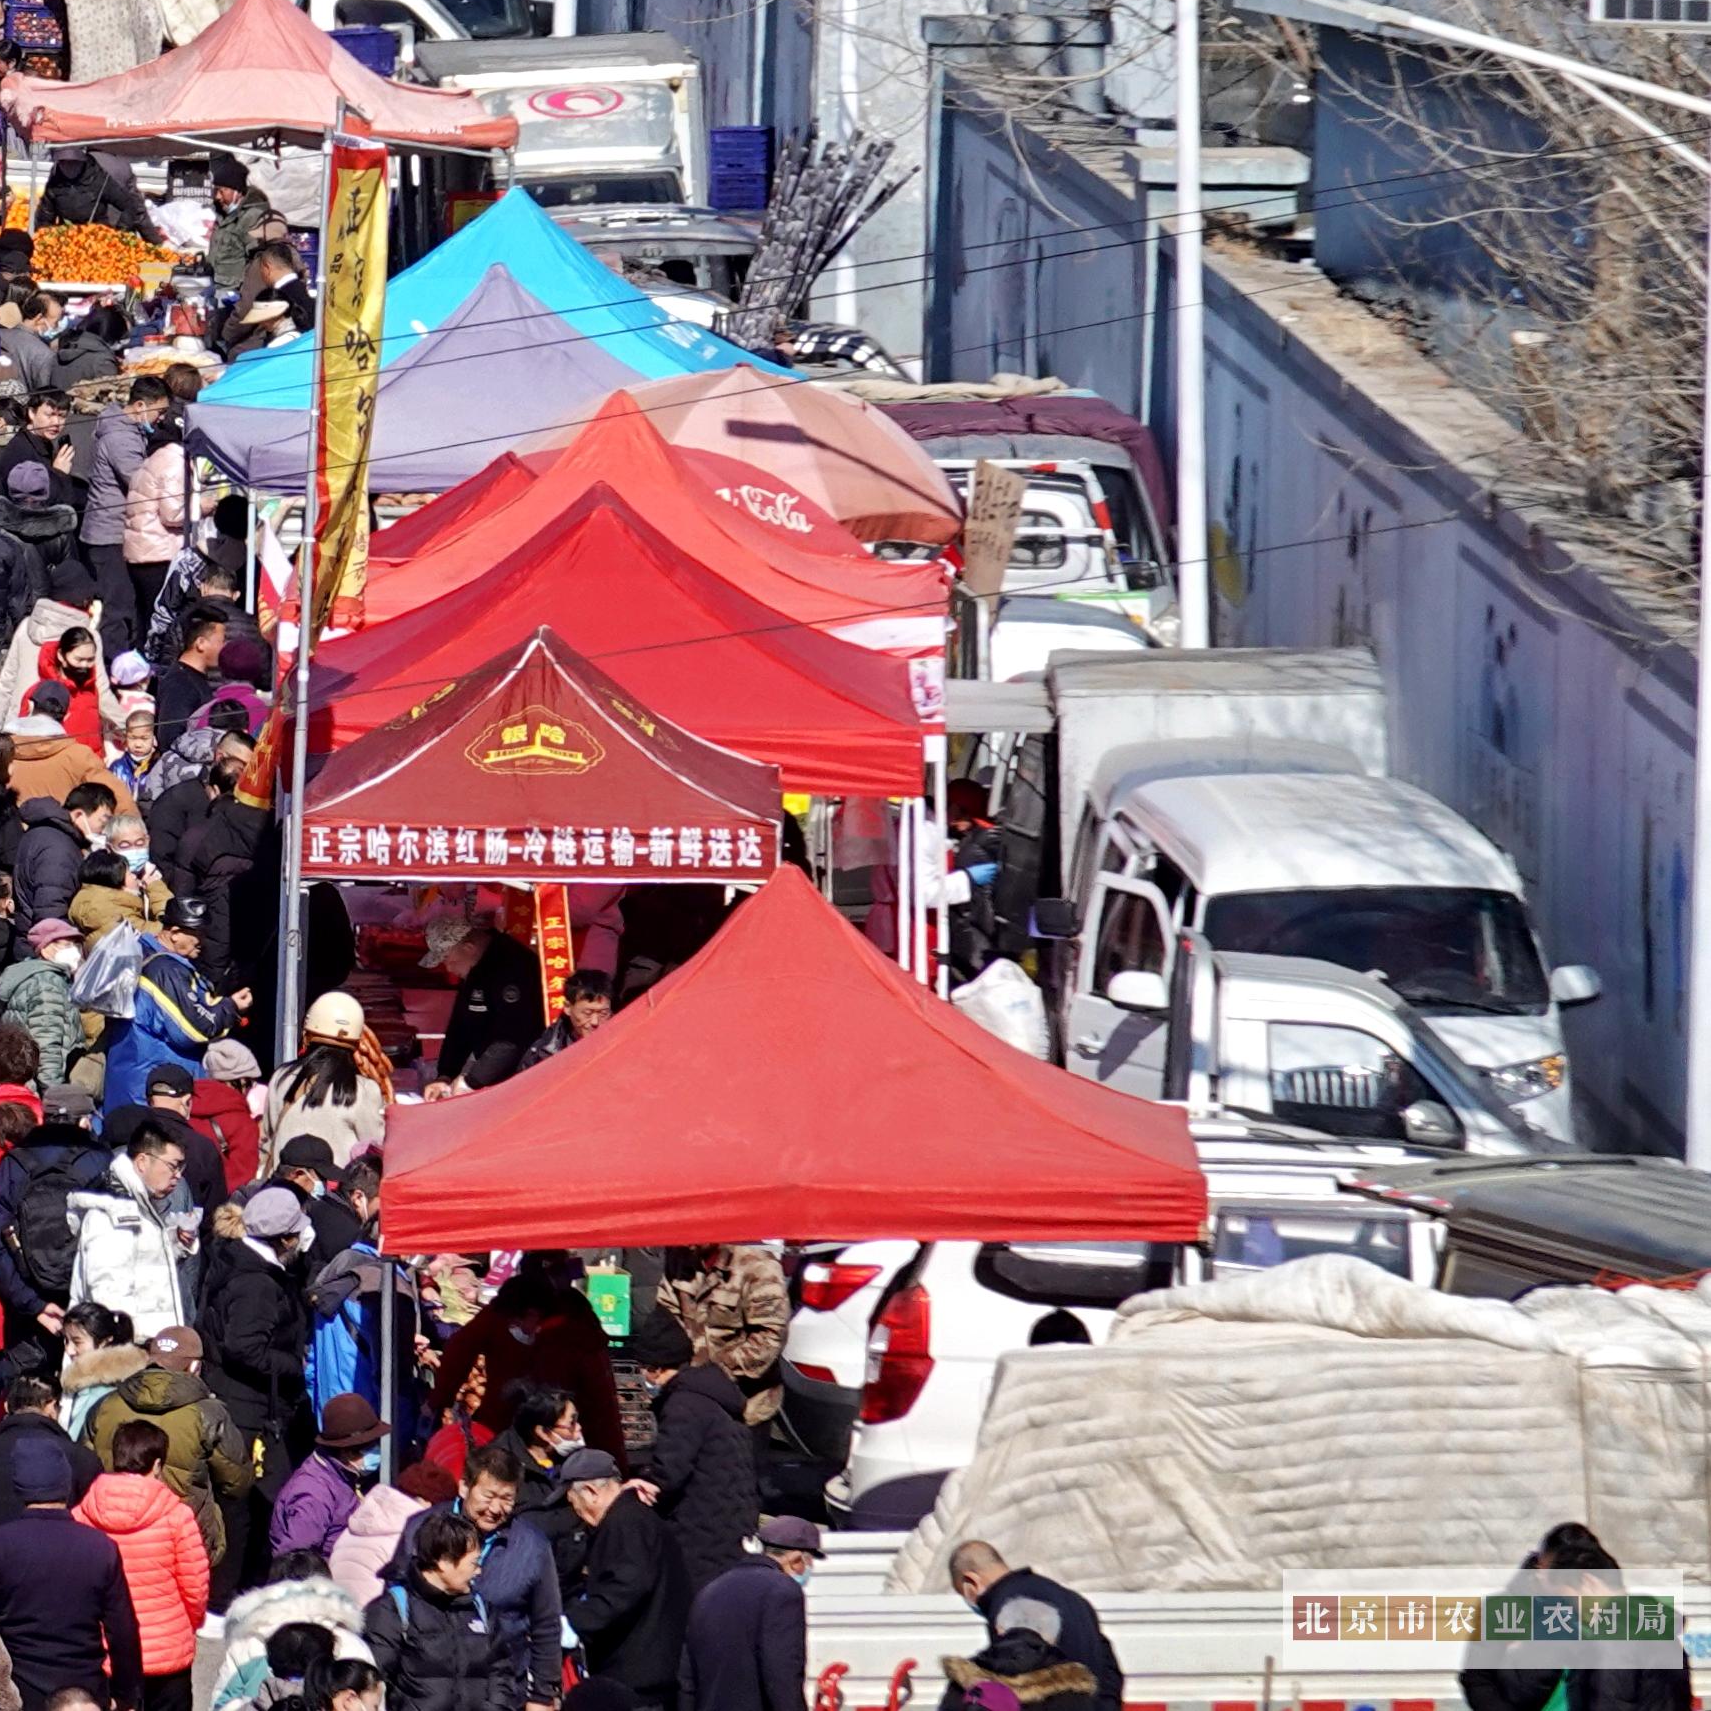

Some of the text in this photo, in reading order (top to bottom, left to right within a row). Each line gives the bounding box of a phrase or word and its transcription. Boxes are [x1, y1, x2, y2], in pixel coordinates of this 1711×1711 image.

[308, 824, 763, 867] 正宗哈尔滨红肠-冷链运输-新鲜送达
